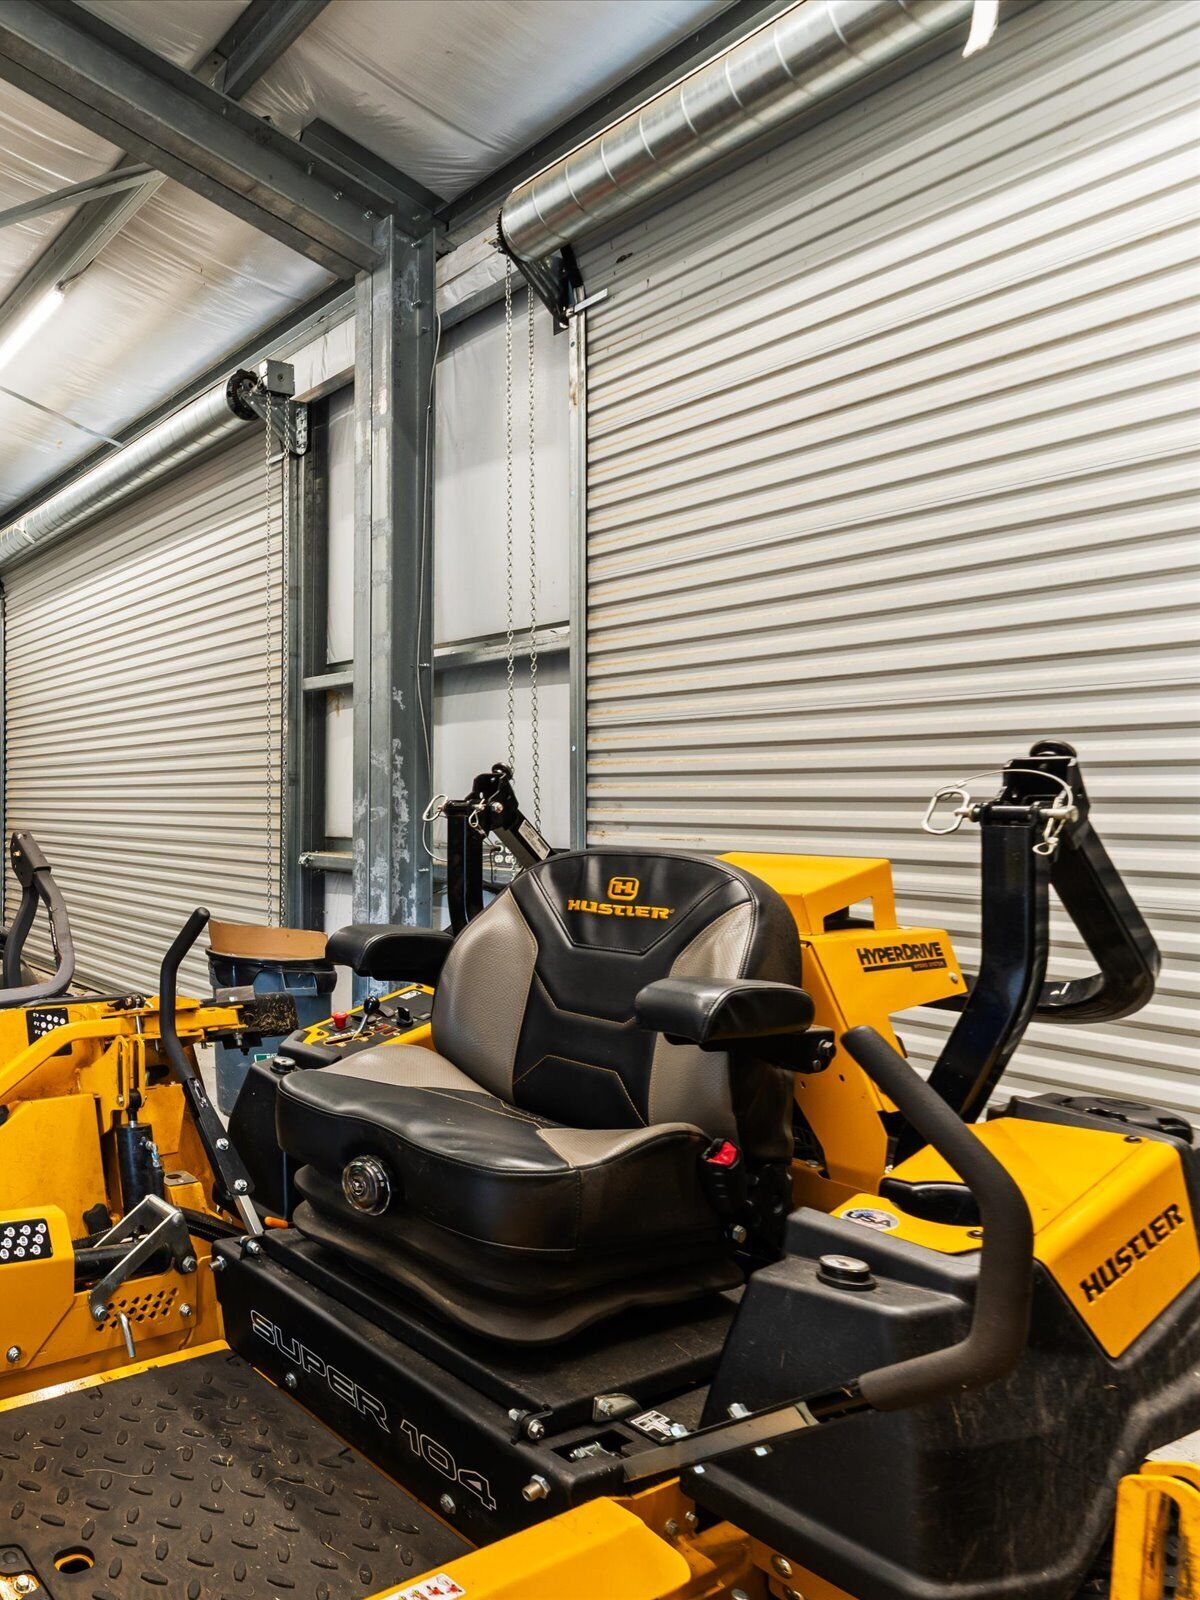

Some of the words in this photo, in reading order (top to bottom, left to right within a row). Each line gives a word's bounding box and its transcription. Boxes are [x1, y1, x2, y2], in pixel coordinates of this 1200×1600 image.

[567, 899, 671, 919] HUSTLER
[856, 942, 944, 965] HYPERDRIVE
[1079, 1203, 1185, 1303] HUSTLER
[250, 1309, 392, 1434] SUPER
[400, 1418, 498, 1512] 104
